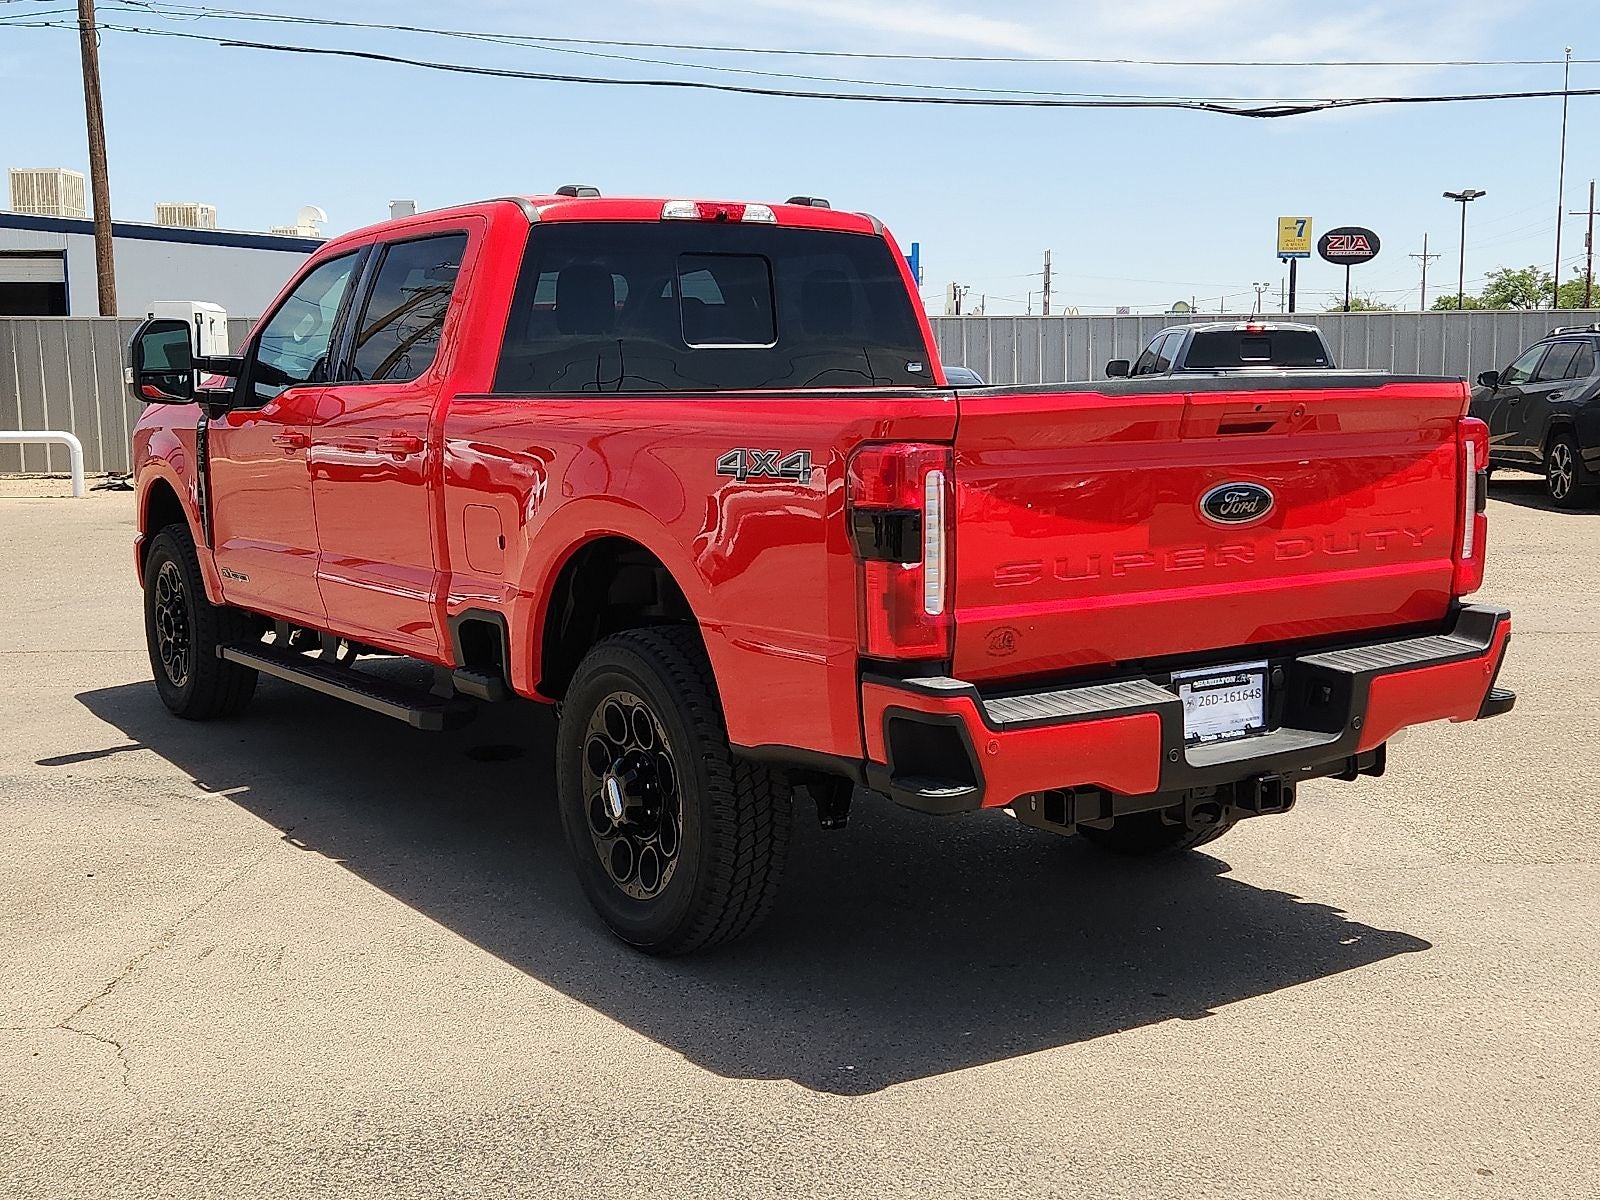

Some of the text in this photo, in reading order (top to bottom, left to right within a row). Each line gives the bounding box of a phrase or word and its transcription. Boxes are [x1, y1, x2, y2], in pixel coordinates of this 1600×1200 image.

[1295, 219, 1307, 237] 7
[1326, 235, 1371, 250] ZIA
[1220, 491, 1259, 515] Ford
[993, 525, 1434, 588] SUPER DUTY
[1198, 688, 1261, 707] 26D-161648
